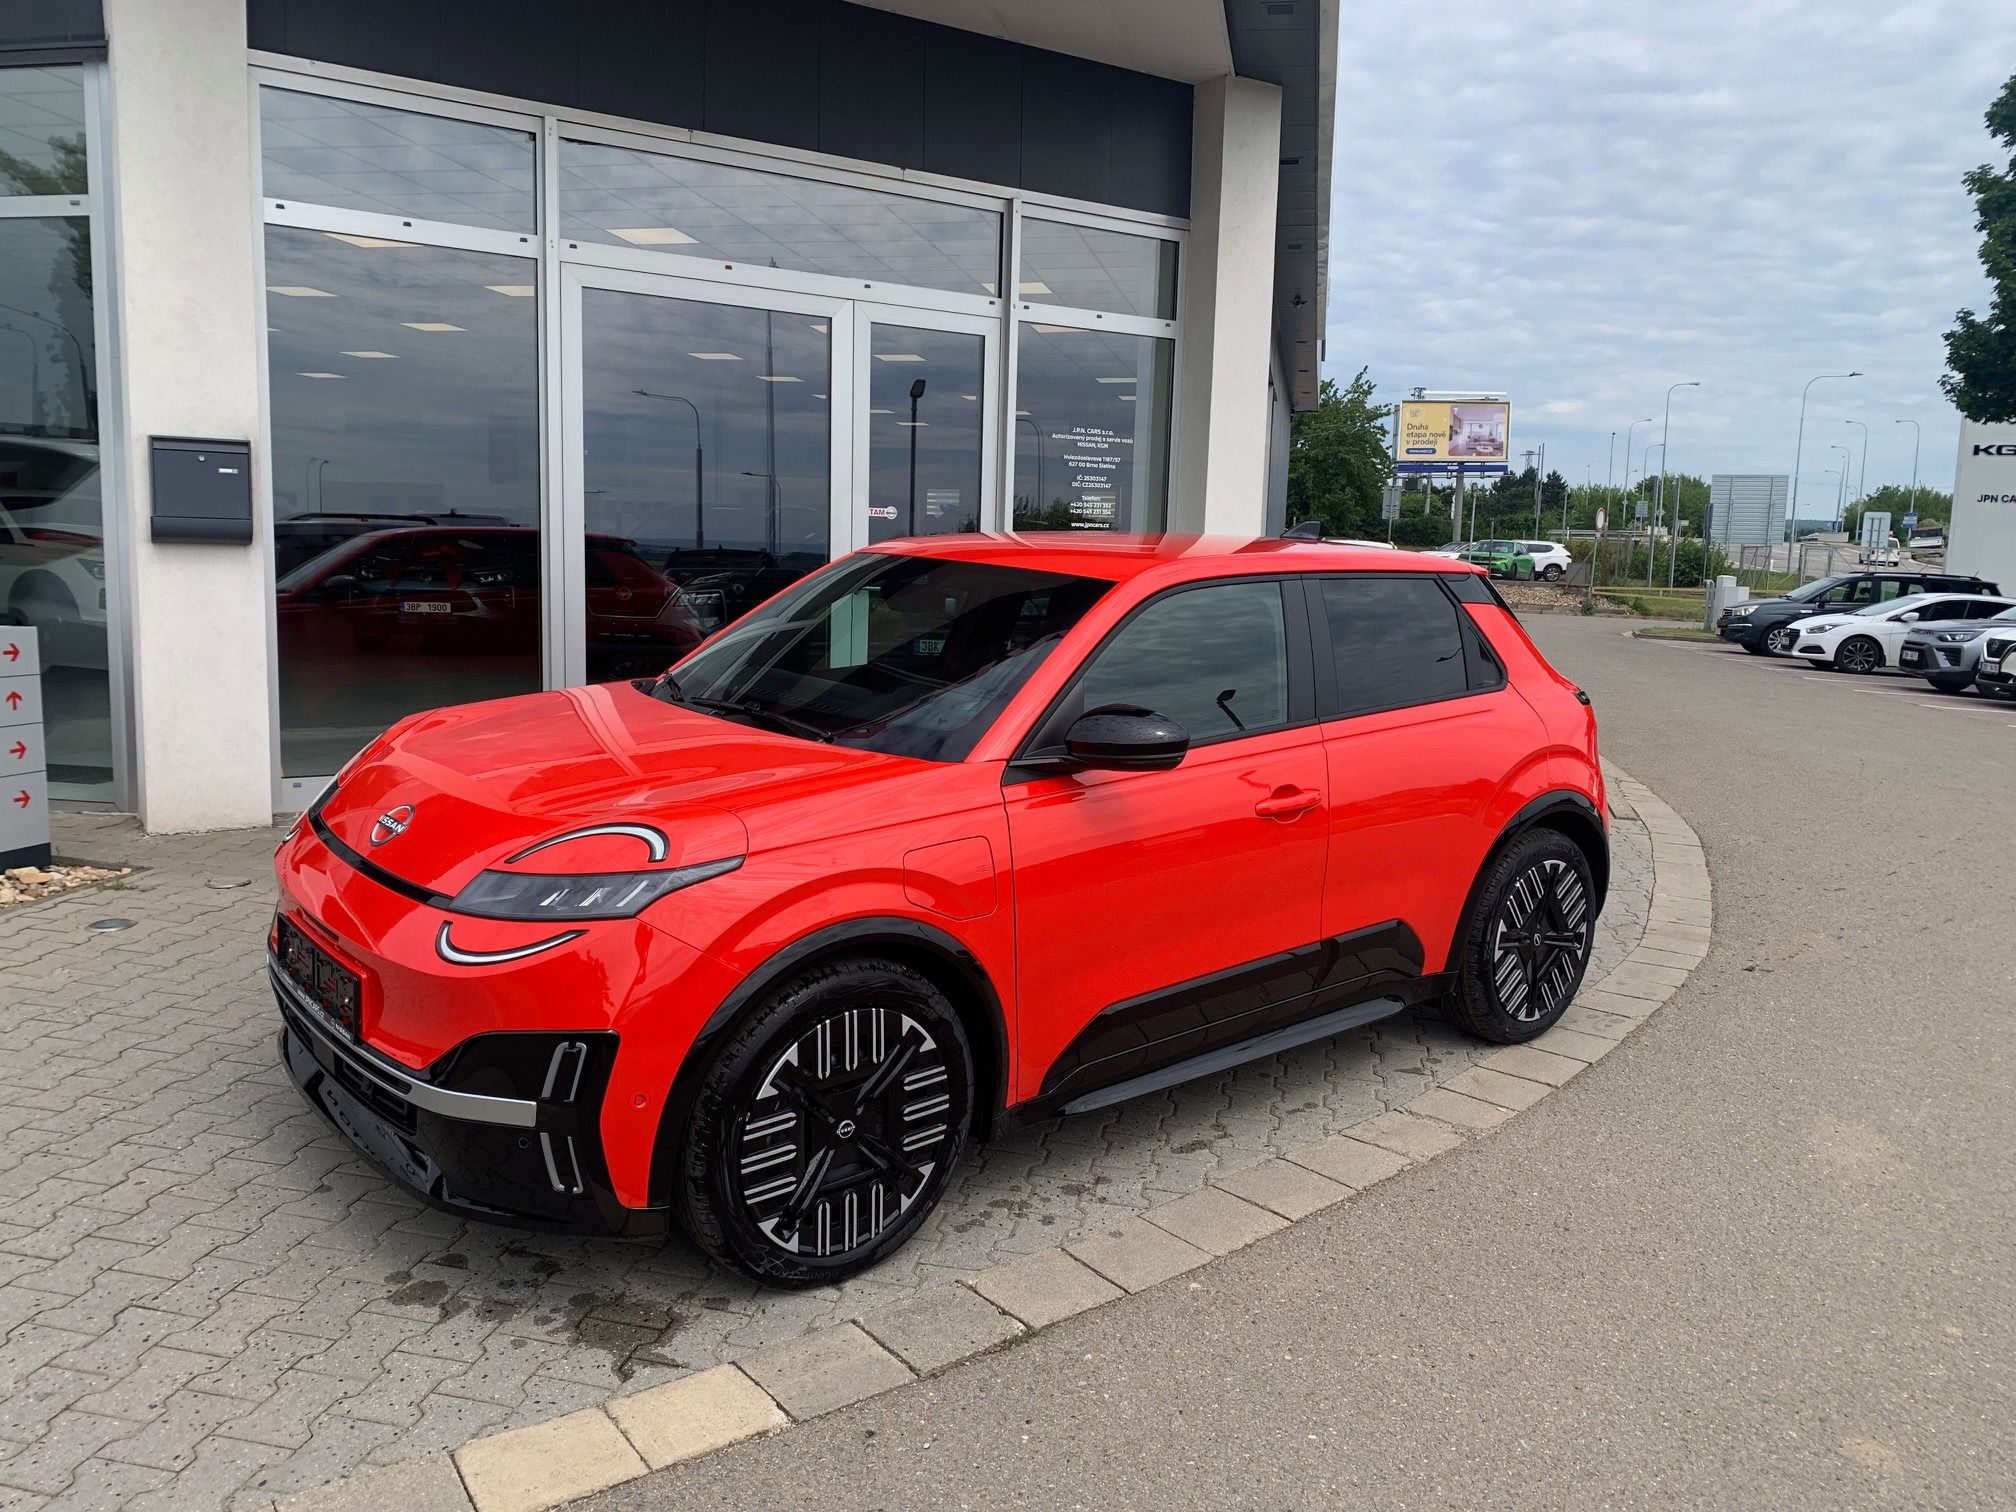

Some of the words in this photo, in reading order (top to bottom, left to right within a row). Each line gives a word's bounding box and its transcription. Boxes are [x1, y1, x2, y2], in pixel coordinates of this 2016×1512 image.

[1052, 433, 1085, 441] Autorizovaný
[1412, 438, 1437, 447] prodeji
[1064, 454, 1102, 462] Hviezdoslavova
[1977, 494, 1999, 503] JPN
[427, 603, 447, 611] 1900
